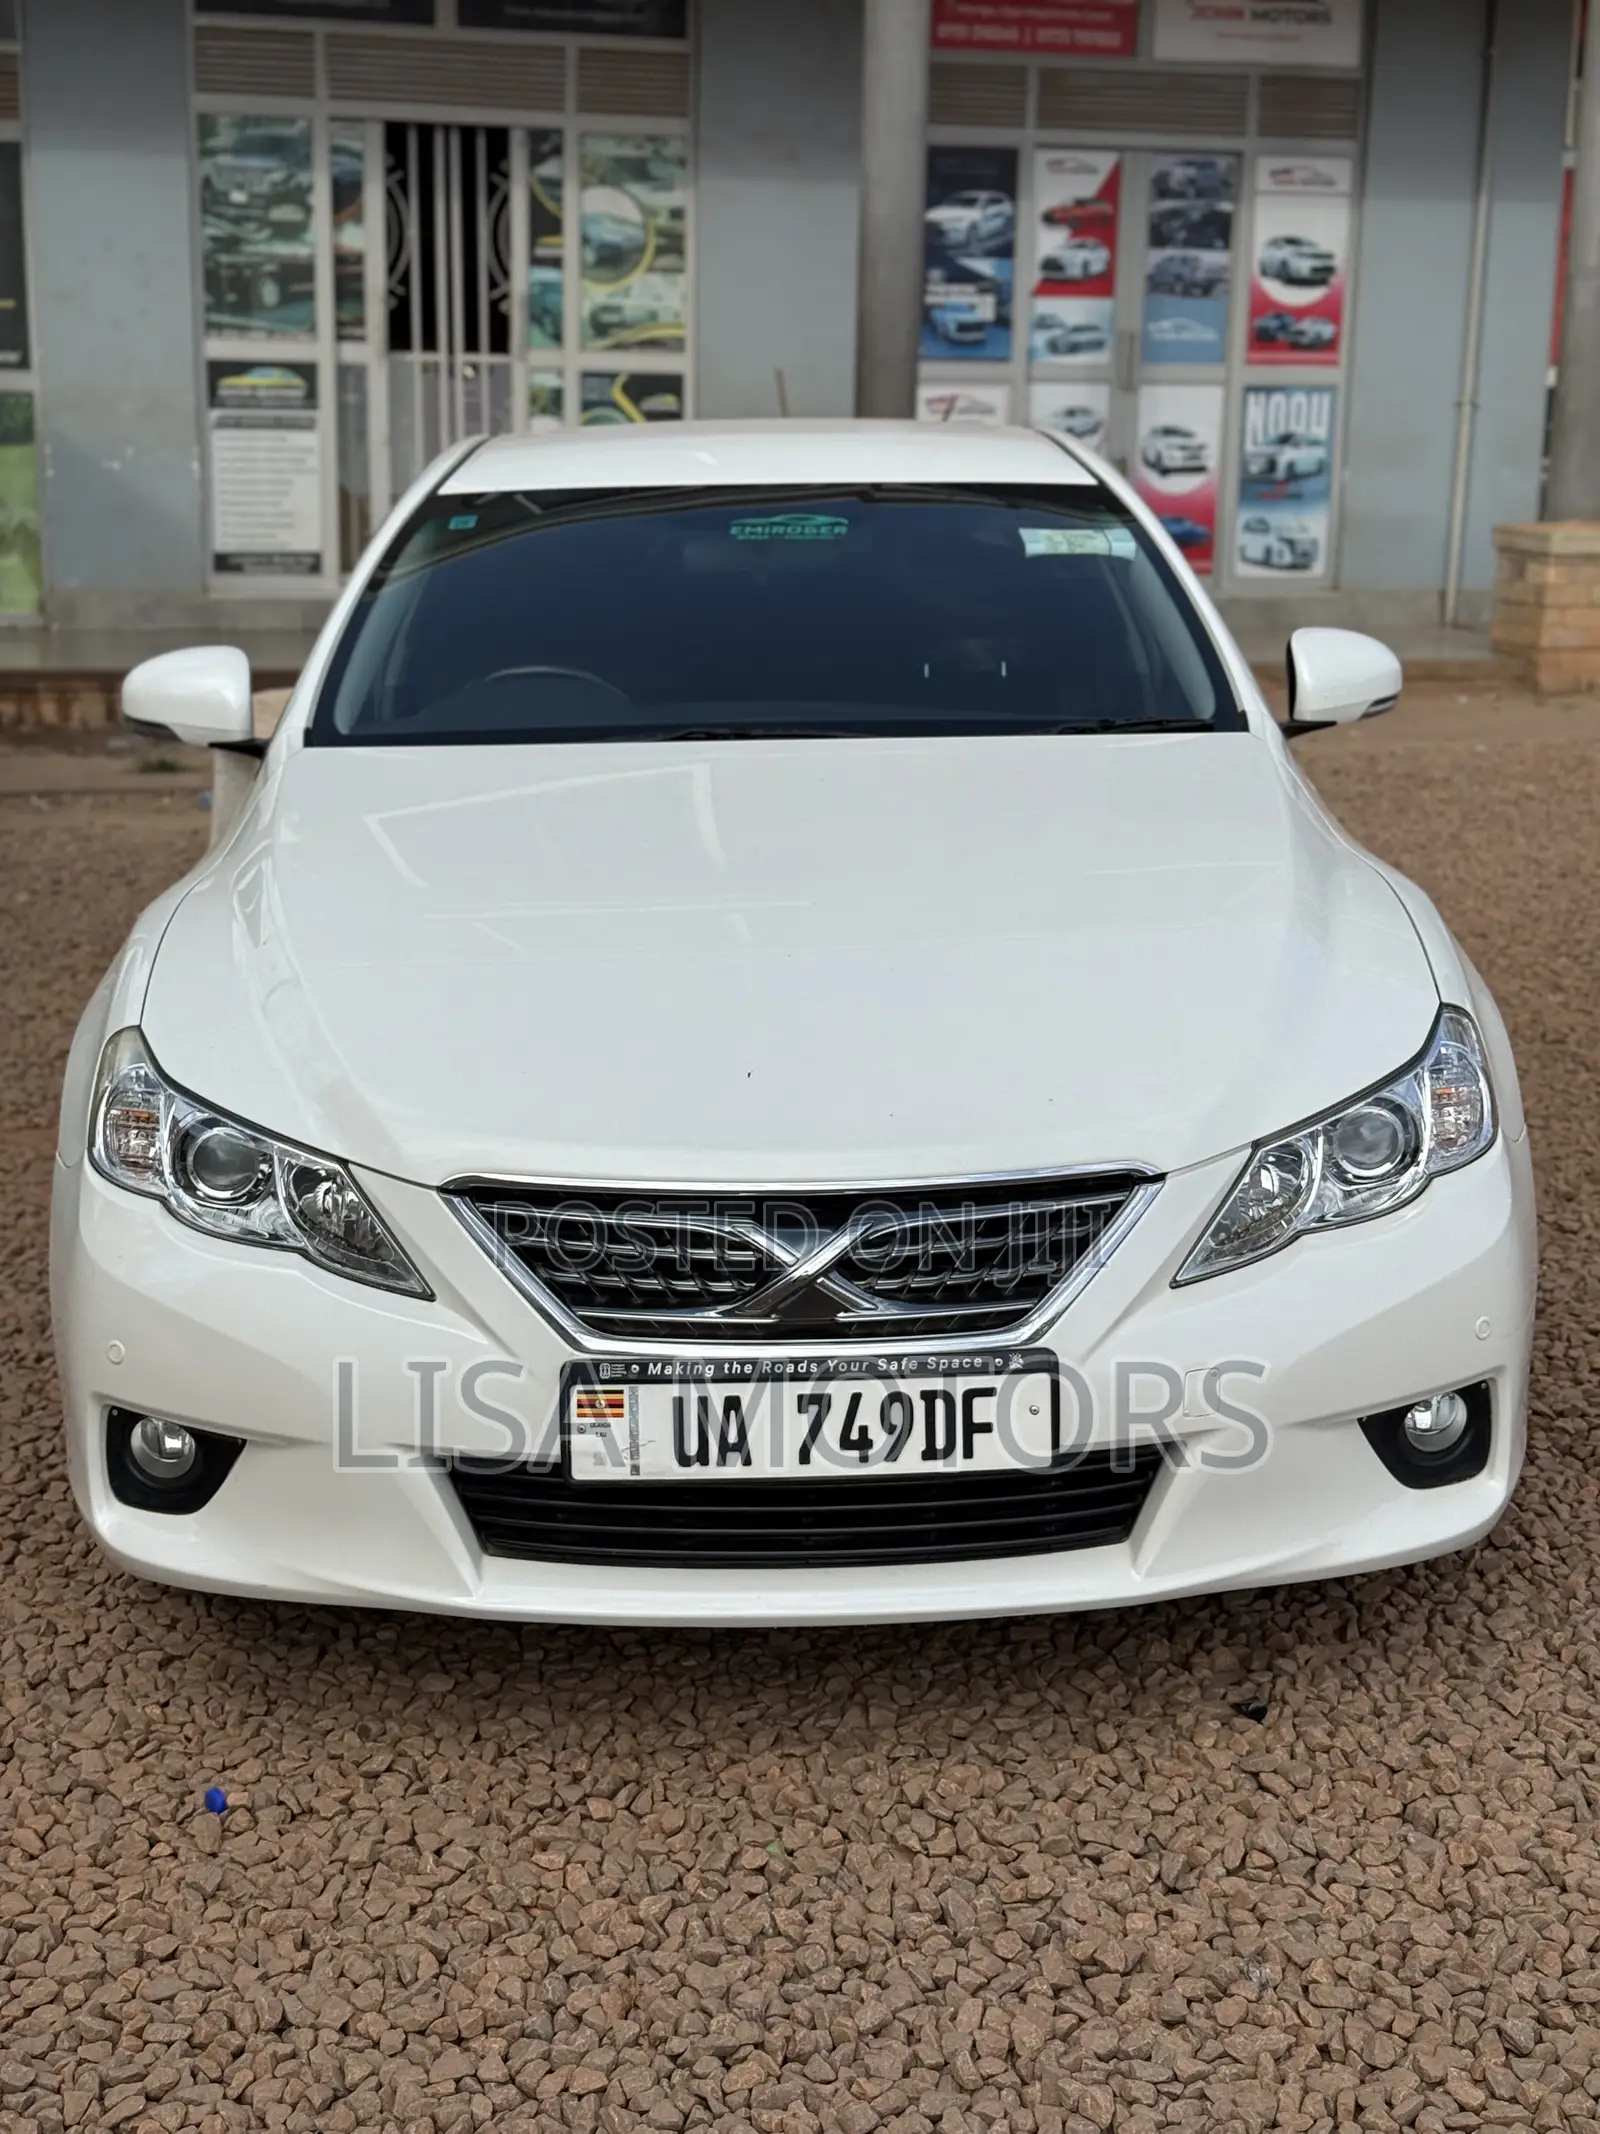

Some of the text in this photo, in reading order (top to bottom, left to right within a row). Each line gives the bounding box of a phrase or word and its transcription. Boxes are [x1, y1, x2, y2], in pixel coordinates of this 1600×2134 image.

[647, 1357, 982, 1377] Making the Roads Your Safe Space
[672, 1387, 998, 1468] UA 749DF
